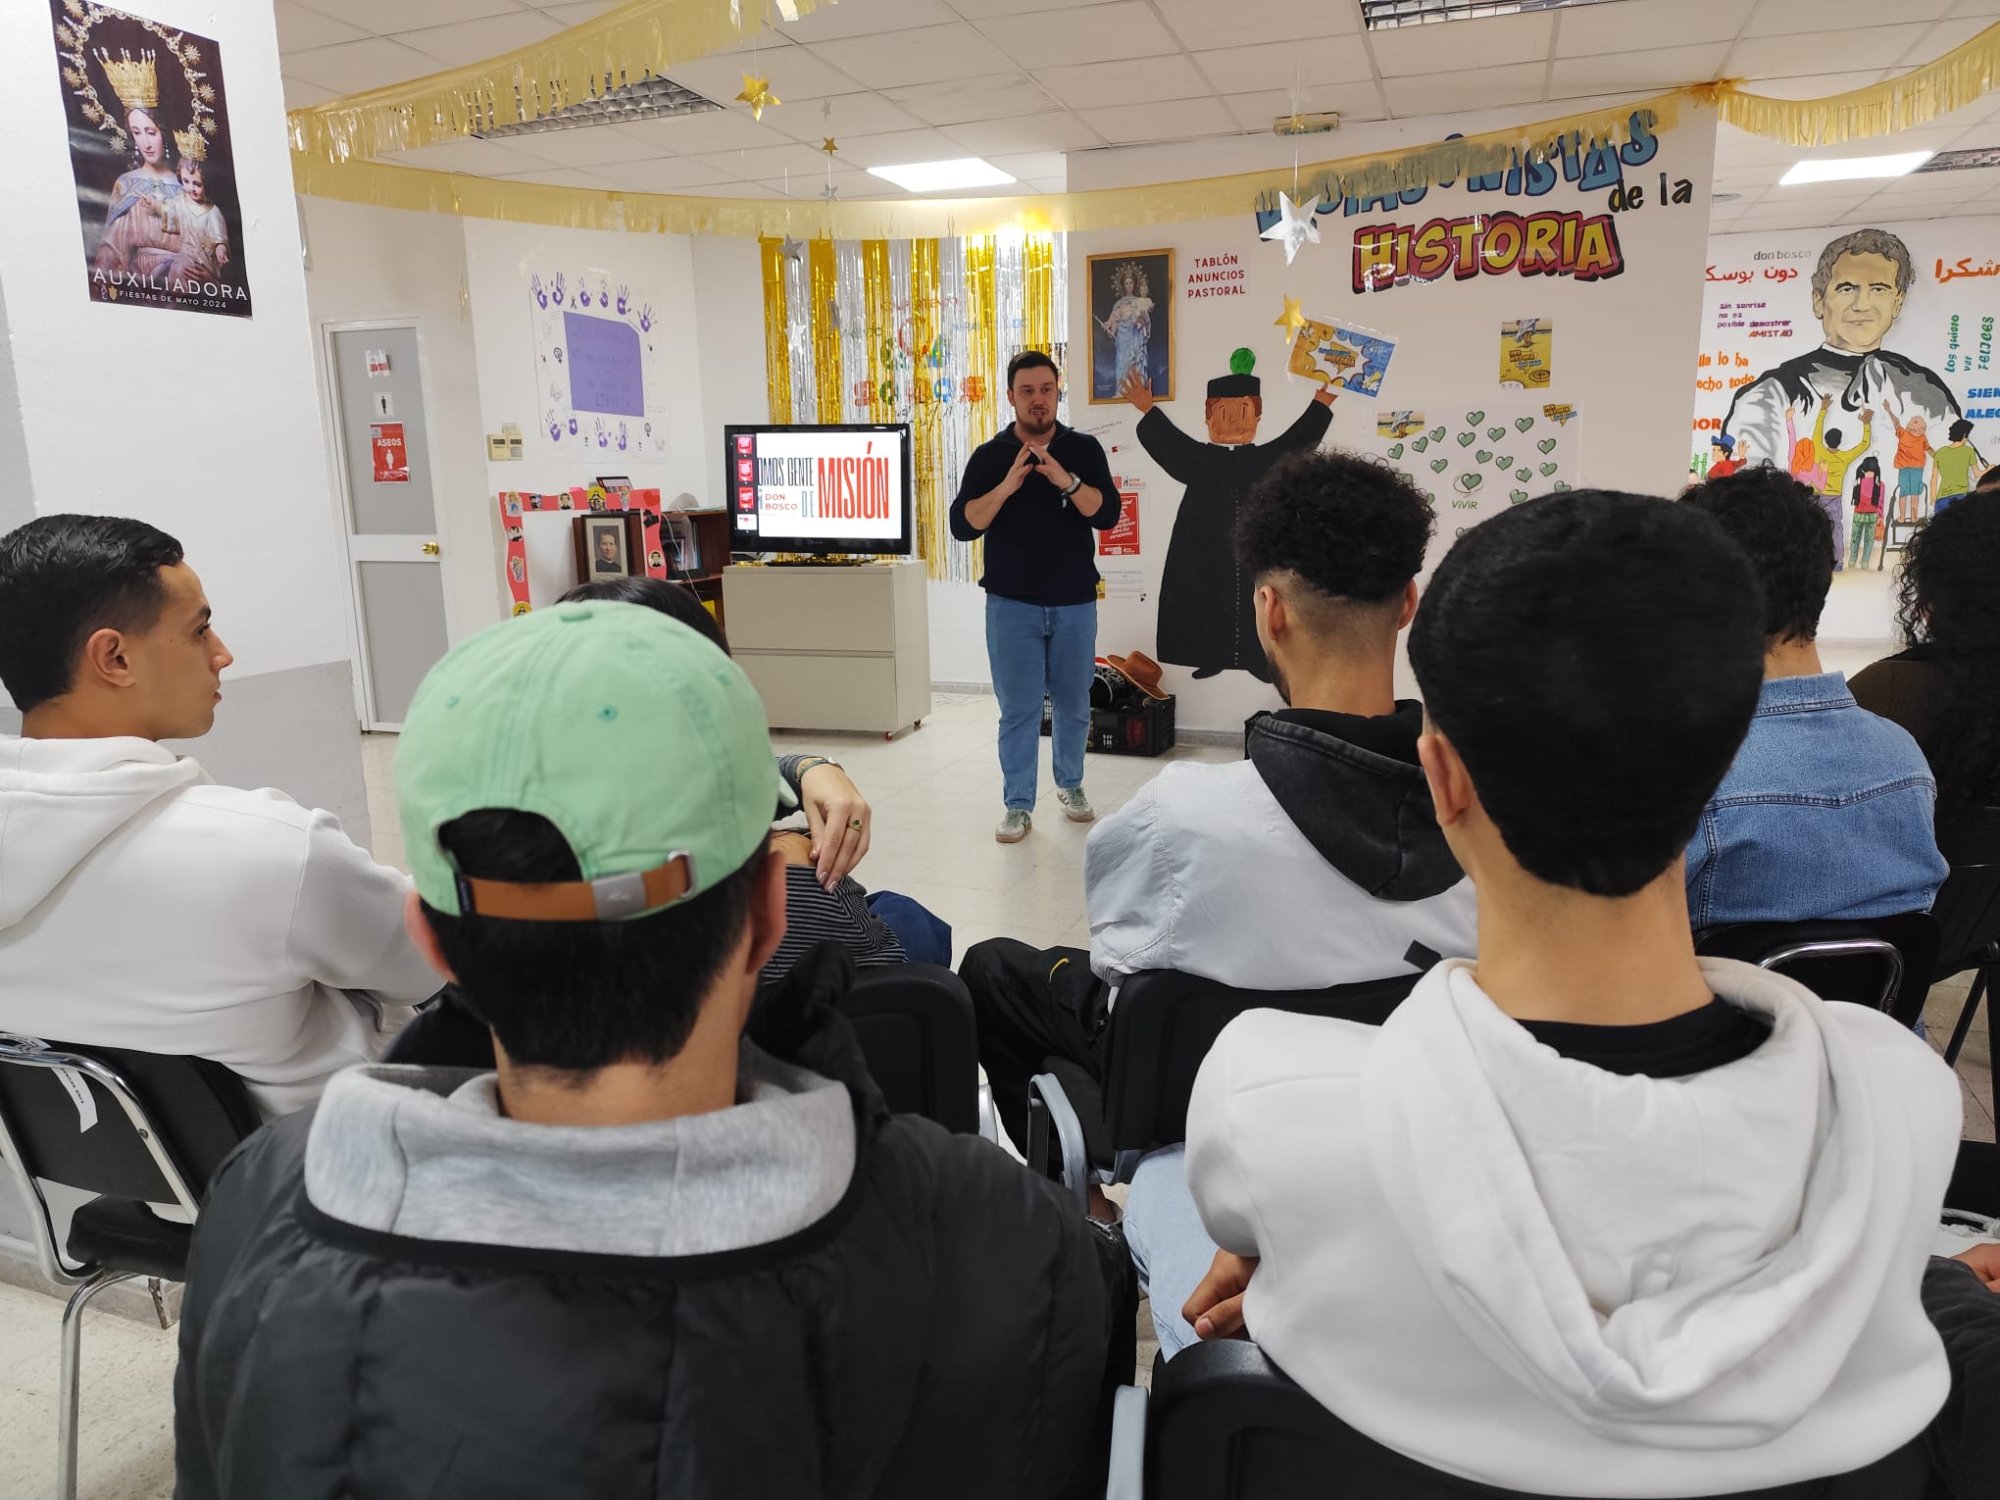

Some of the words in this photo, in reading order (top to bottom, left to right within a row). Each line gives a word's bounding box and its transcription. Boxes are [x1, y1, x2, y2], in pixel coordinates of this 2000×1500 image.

[1608, 179, 1644, 213] de
[1659, 171, 1693, 206] la
[1194, 253, 1239, 268] TABLÓN
[1353, 211, 1624, 295] HISTORIA
[1188, 270, 1245, 284] ANUNCIOS
[1764, 265, 1798, 283] دون
[93, 268, 248, 301] AUXILIADORA
[1187, 285, 1246, 299] PASTORAL
[119, 290, 158, 301] FIESTAS
[161, 293, 172, 303] DE
[175, 297, 199, 306] MAYO
[202, 299, 227, 309] 2024
[1718, 350, 1729, 366] lo
[377, 438, 402, 447] ASEOS
[787, 457, 815, 487] GENTE
[817, 441, 890, 520] MISIÓN
[765, 493, 786, 501] DON
[801, 490, 816, 518] DE
[765, 503, 798, 511] BOSCO
